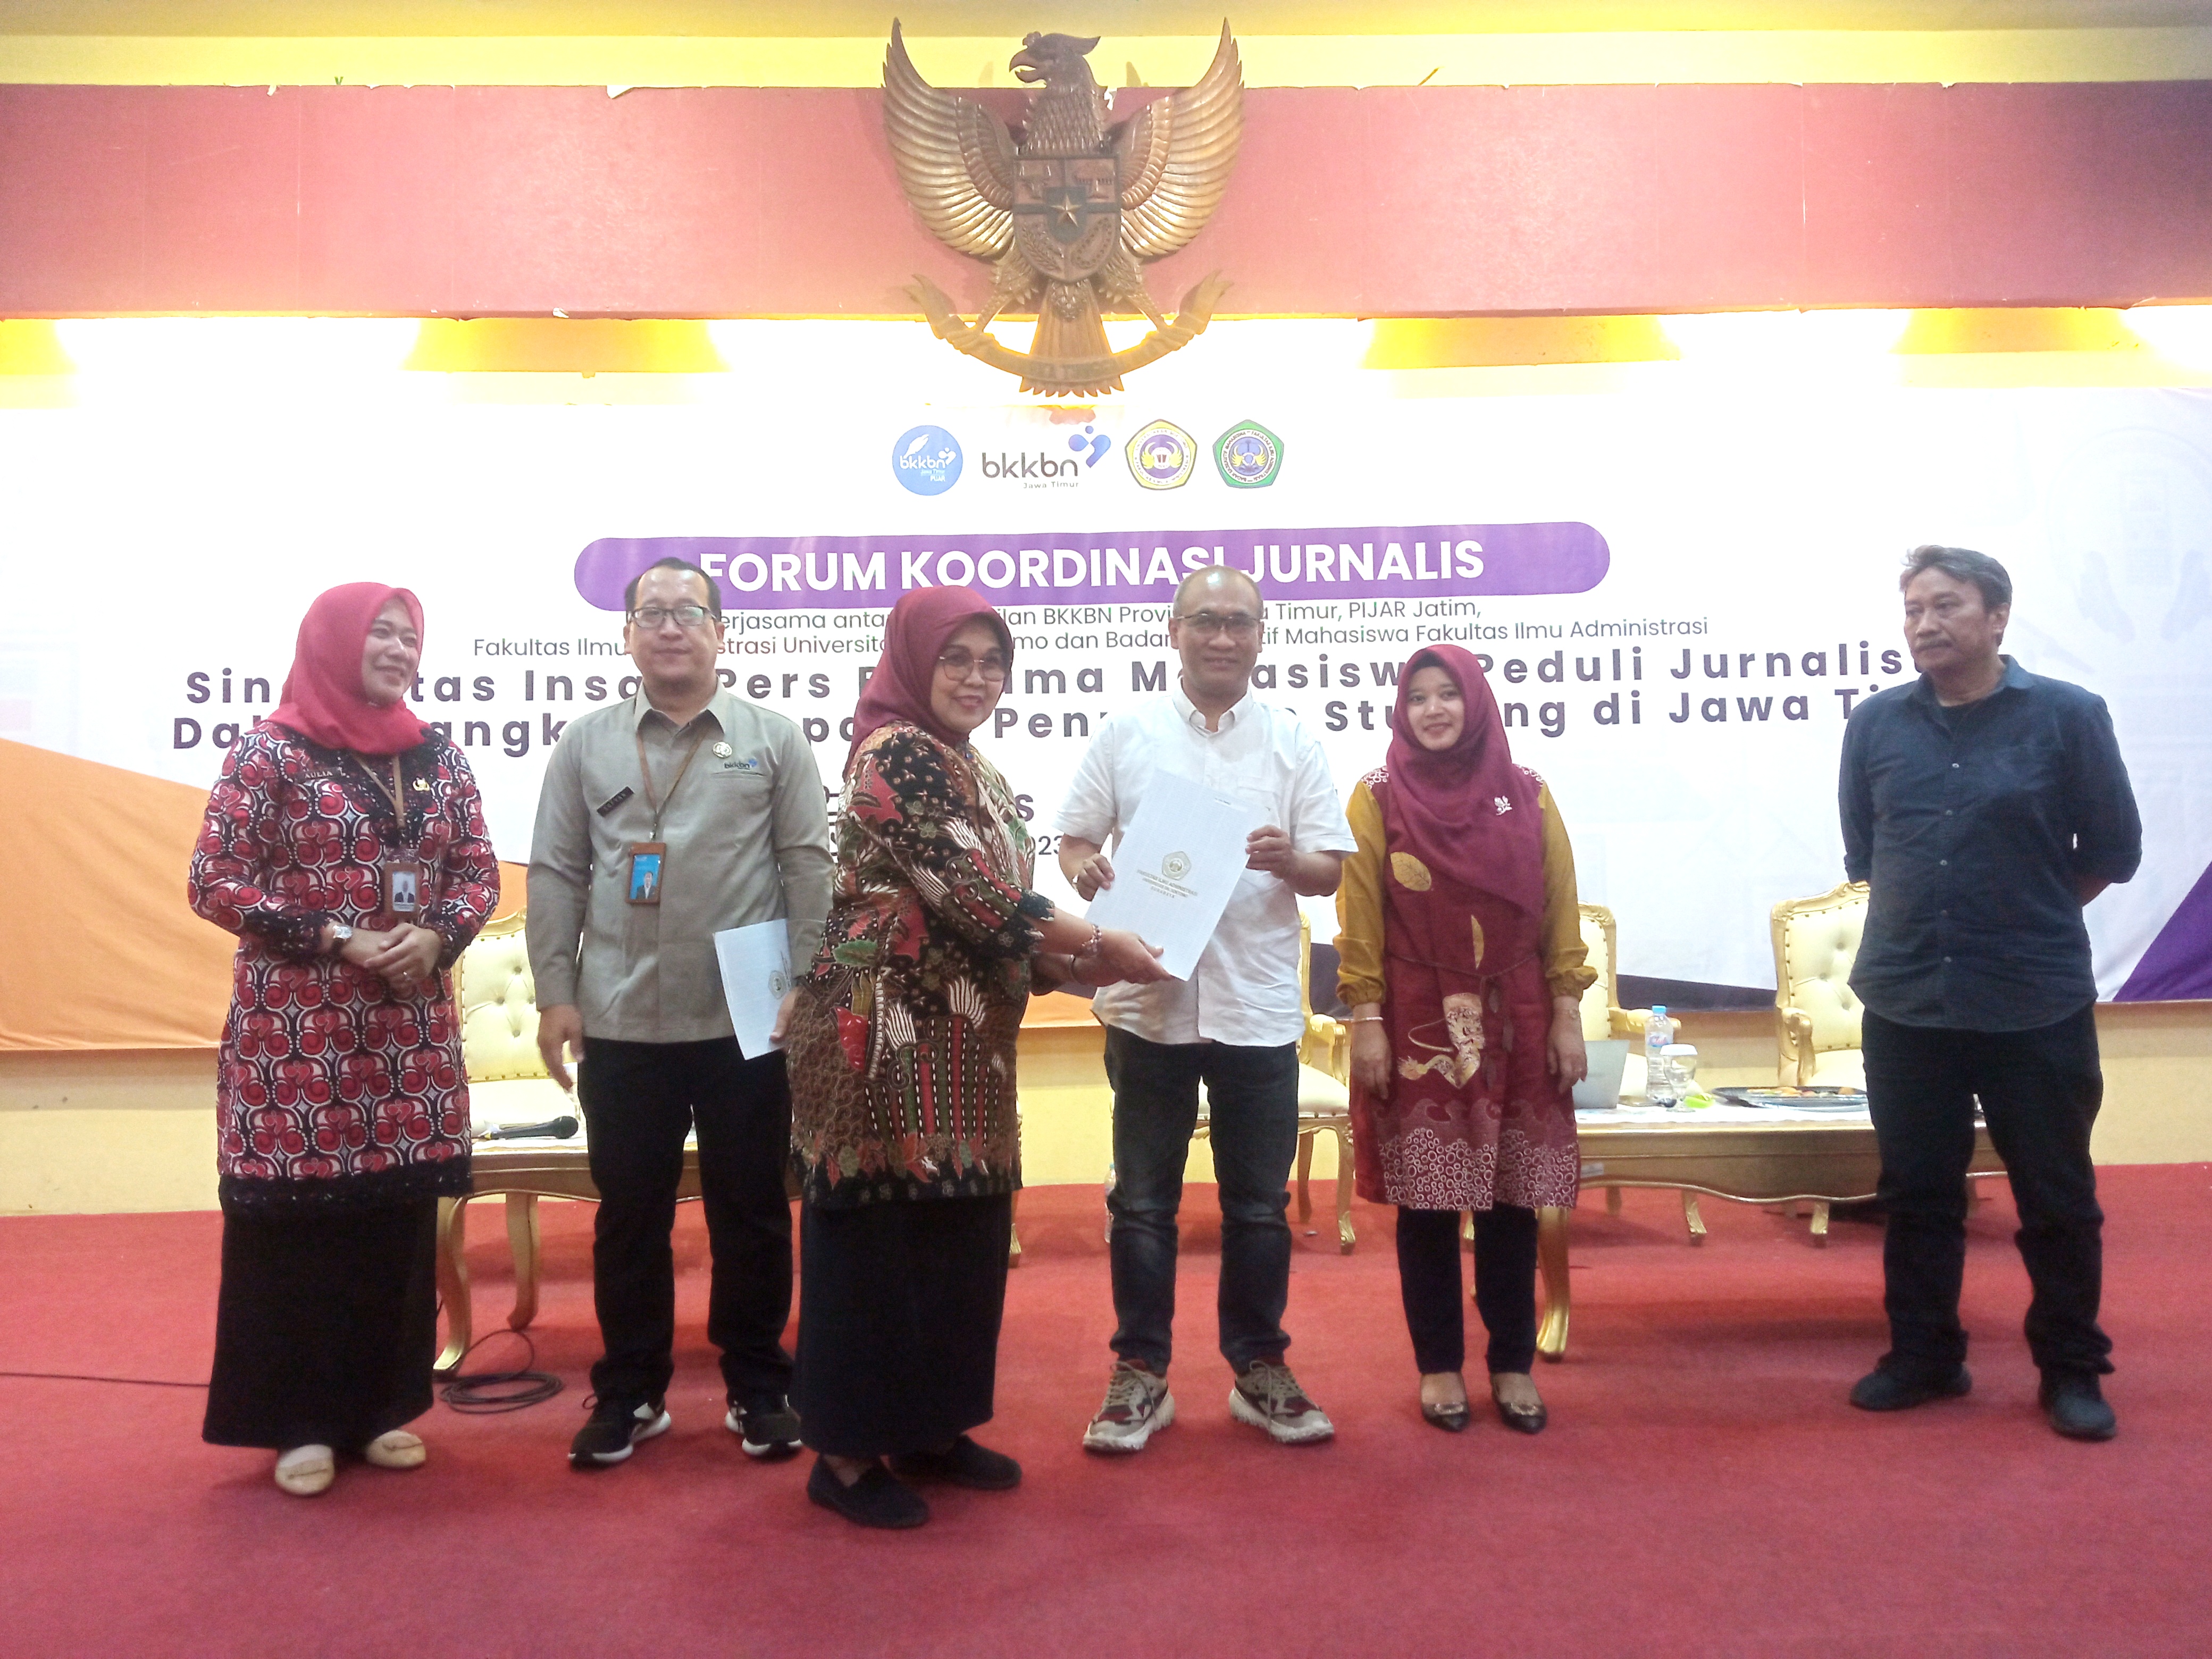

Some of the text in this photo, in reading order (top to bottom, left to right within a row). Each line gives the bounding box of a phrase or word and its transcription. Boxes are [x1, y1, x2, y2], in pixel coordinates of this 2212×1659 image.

[900, 455, 945, 469] bkkbn
[982, 452, 1078, 478] bkkbn
[700, 552, 886, 592] FORUM
[1241, 540, 1485, 583] JURNALIS
[721, 611, 825, 635] erjasama
[833, 611, 885, 629] anta
[1044, 607, 1112, 625] BKKBN
[1119, 605, 1171, 623] Provi
[1275, 602, 1343, 622] Timur,
[1349, 601, 1406, 618] PIJAR
[1413, 599, 1481, 619] Jatim,
[474, 638, 570, 656] Fakultas
[578, 638, 626, 656] Ilmu
[784, 634, 885, 655] Universit
[1055, 632, 1099, 649] dan
[1285, 625, 1409, 644] Mahasiswa
[1416, 623, 1509, 642] Fakultas
[1515, 621, 1563, 640] Ilmu
[1570, 616, 1708, 638] Administrasi
[525, 670, 643, 701] Insa
[715, 666, 830, 699] Pers
[1670, 640, 1903, 680] Jurnalis
[1594, 690, 1641, 725] di
[1669, 692, 1809, 724] Jawa
